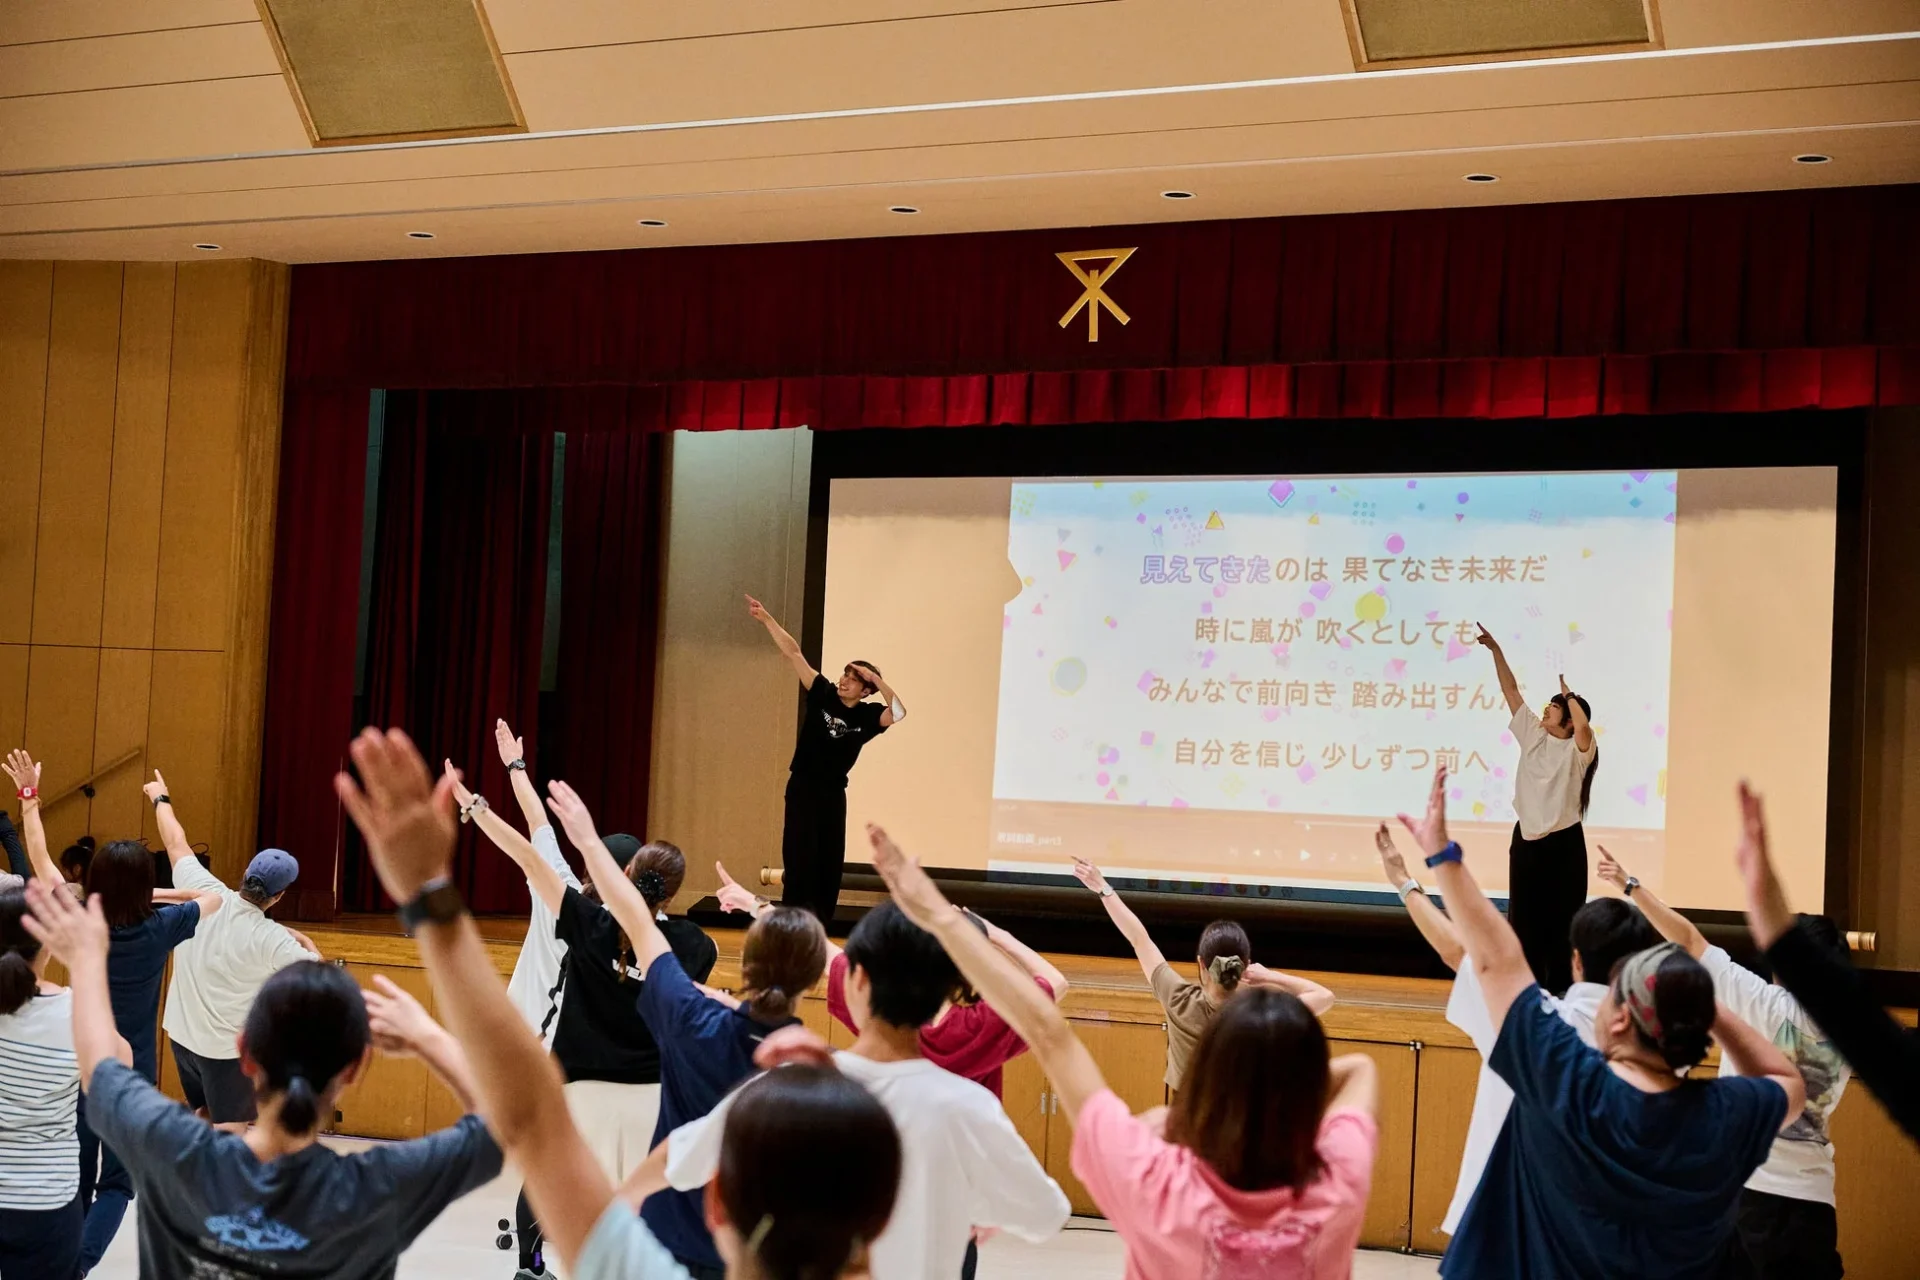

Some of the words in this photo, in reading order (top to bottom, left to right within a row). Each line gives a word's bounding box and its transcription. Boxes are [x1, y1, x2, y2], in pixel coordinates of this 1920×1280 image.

[1140, 555, 1328, 584] 見えてきたのは
[1343, 555, 1548, 583] 果てなき未来だ
[1195, 617, 1302, 644] 時に嵐が
[1317, 618, 1477, 646] 吹くとしても
[1149, 678, 1337, 707] みんなで前向き
[1352, 682, 1526, 710] 踏み出すん
[1175, 738, 1306, 768] 自分を信じ
[1322, 742, 1490, 774] 少しずつ前へ
